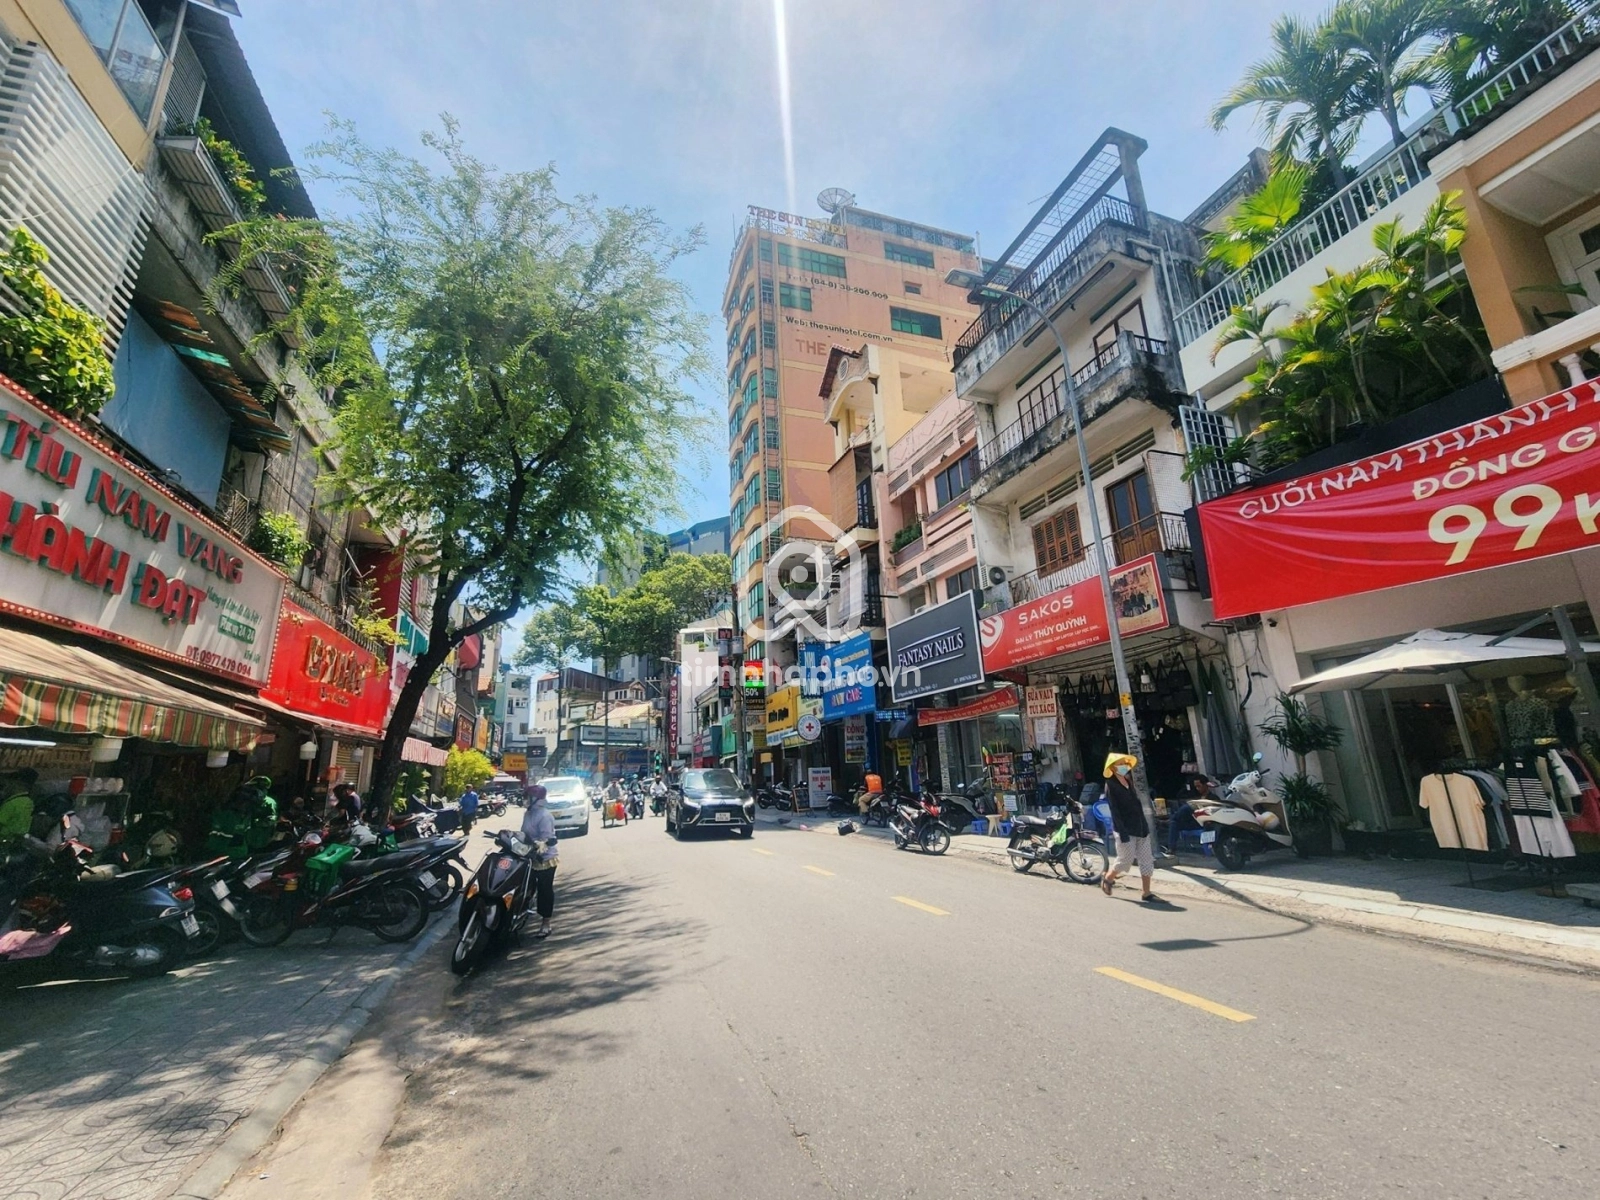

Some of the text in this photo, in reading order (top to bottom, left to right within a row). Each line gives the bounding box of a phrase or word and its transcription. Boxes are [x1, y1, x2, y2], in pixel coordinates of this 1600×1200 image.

[809, 321, 893, 342] thesunhotel.com.vn
[795, 339, 827, 357] THE
[1408, 392, 1578, 463] THANH
[1412, 443, 1547, 500] ĐỒNG
[88, 469, 172, 543] NAM
[177, 522, 245, 585] VANG
[131, 562, 208, 628] ĐẠT
[1018, 595, 1074, 625] SAKOS
[1034, 625, 1055, 639] THÚY
[1055, 615, 1087, 633] QUỲNH
[200, 650, 221, 669] 0977
[221, 657, 237, 671] 479
[237, 662, 252, 676] 094
[897, 642, 934, 668] FANTASY
[934, 632, 964, 656] NAILS
[745, 687, 759, 696] 50%
[1028, 687, 1054, 701] SỬA VALY
[1029, 702, 1039, 714] TÚI
[1039, 701, 1056, 714] XÁCH
